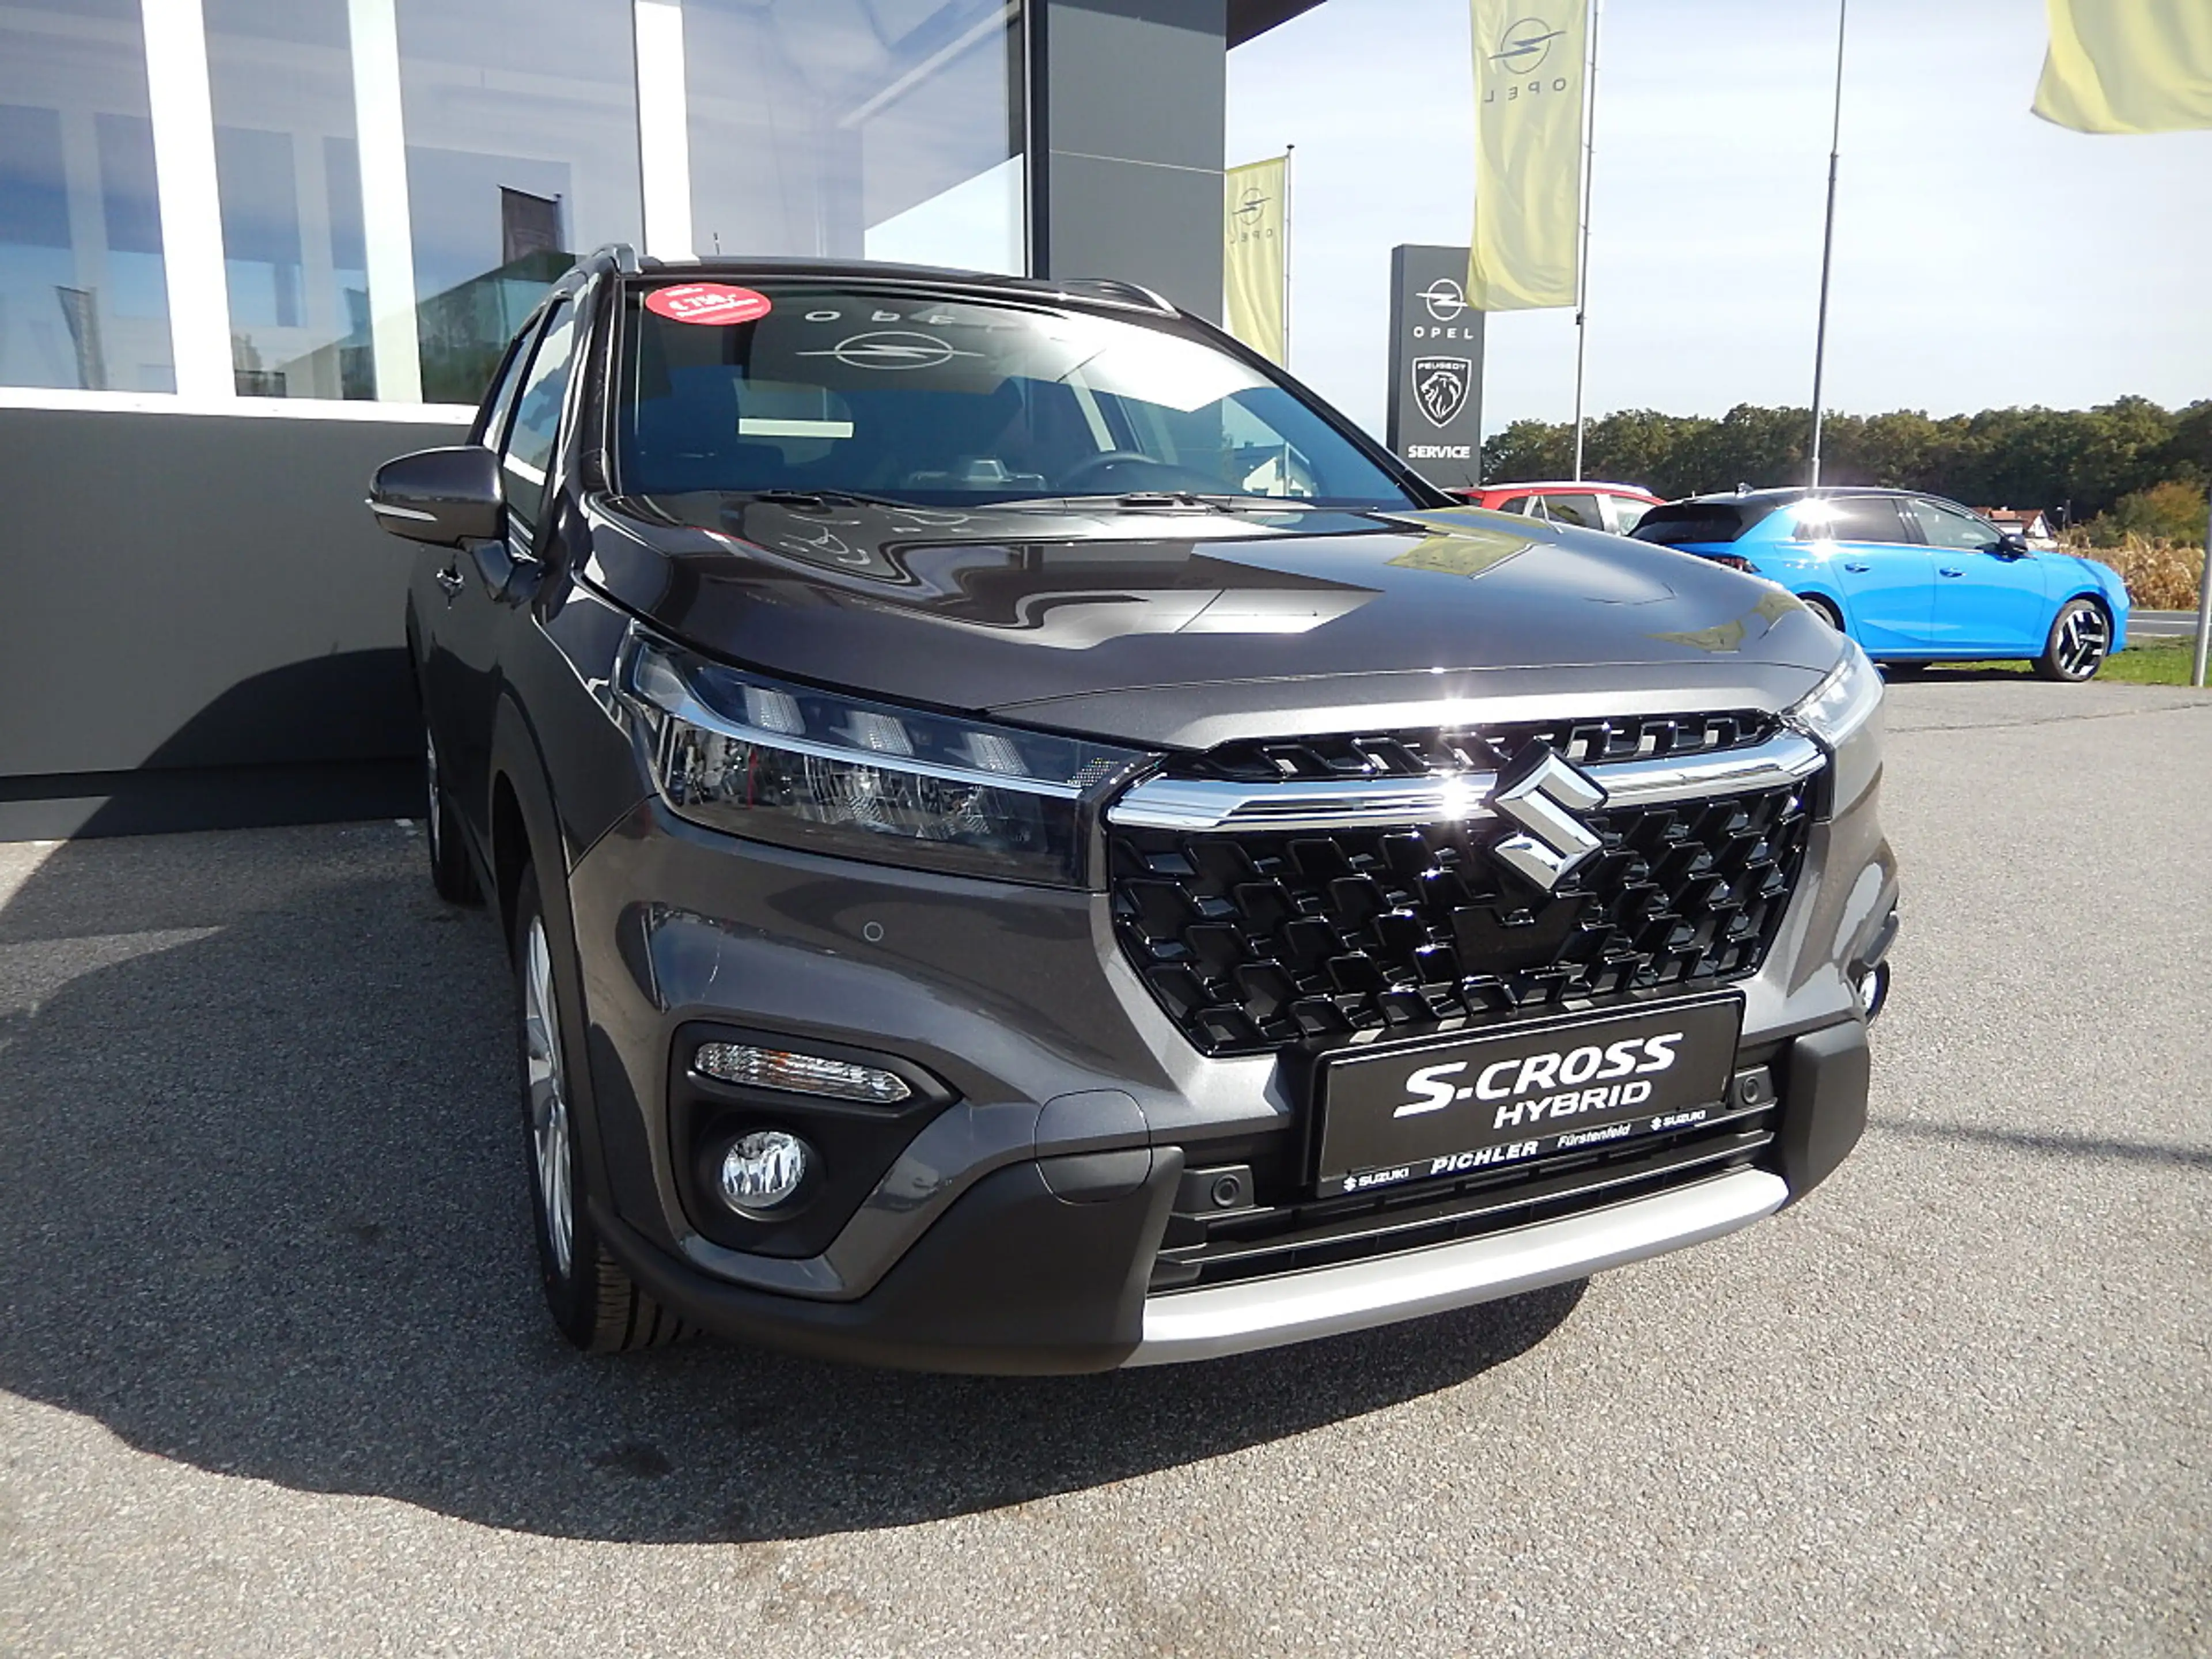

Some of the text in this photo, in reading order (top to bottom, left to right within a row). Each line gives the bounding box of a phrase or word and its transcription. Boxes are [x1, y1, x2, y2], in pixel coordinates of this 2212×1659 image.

[1413, 325, 1474, 339] OPEL
[1407, 445, 1471, 459] SERVICE
[1393, 1032, 1684, 1118] S-CROSS
[1493, 1080, 1652, 1129] HYBRID
[1358, 1109, 1706, 1186] SUZUKI PICHLER Fürstenfeld SUZUKI
